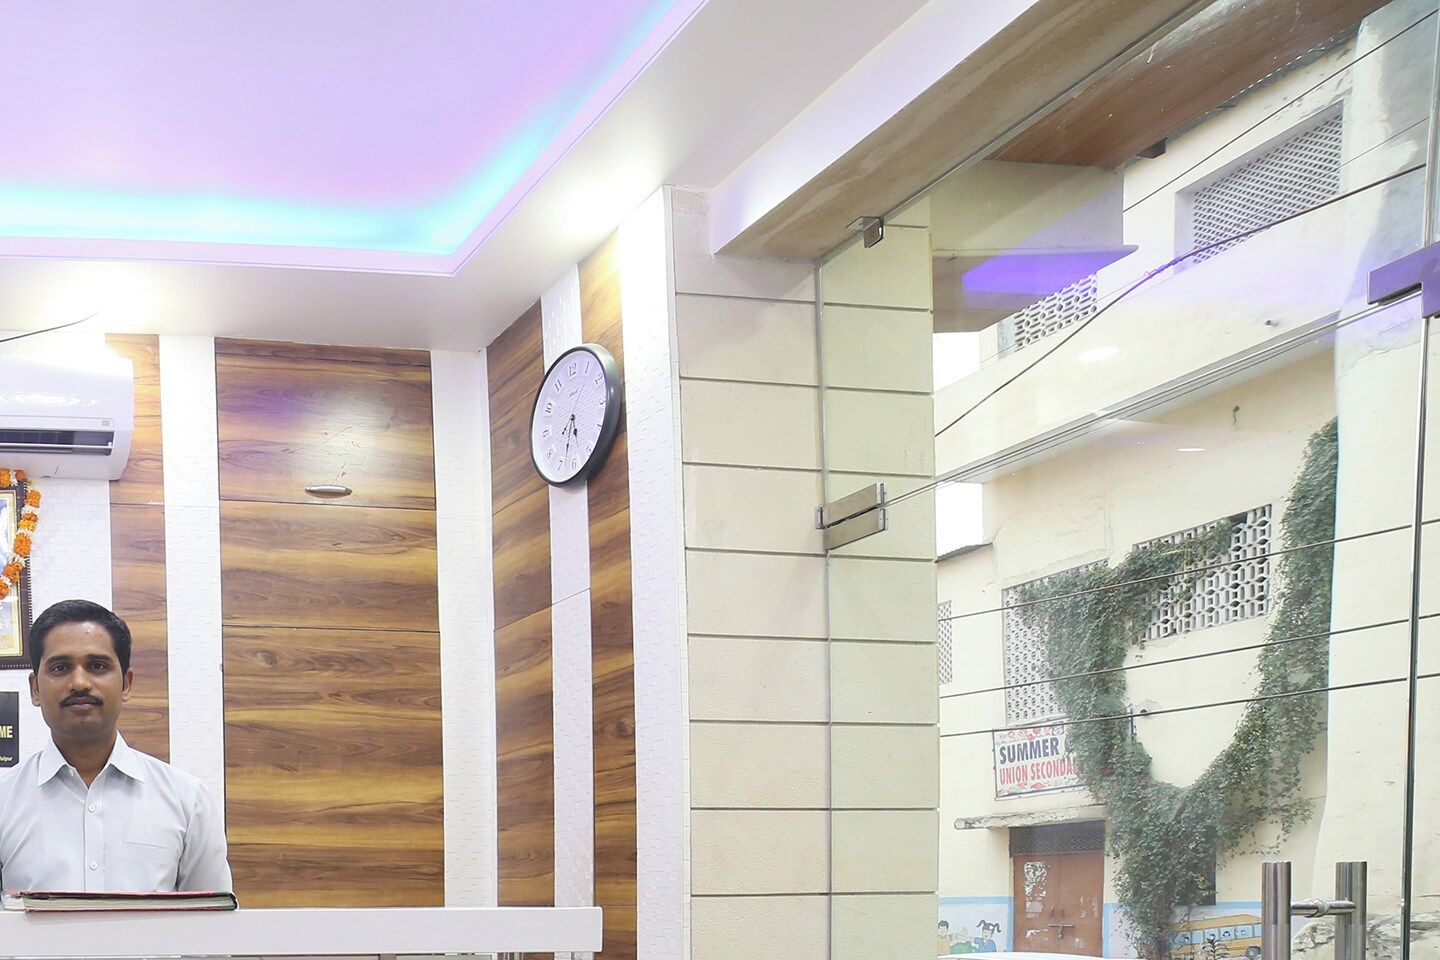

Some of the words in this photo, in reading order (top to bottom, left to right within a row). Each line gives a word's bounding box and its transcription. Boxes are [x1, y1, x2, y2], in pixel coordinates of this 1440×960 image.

[1000, 737, 1059, 764] SUMMER
[1000, 765, 1028, 785] UNION
[1031, 757, 1079, 780] SECONDA
